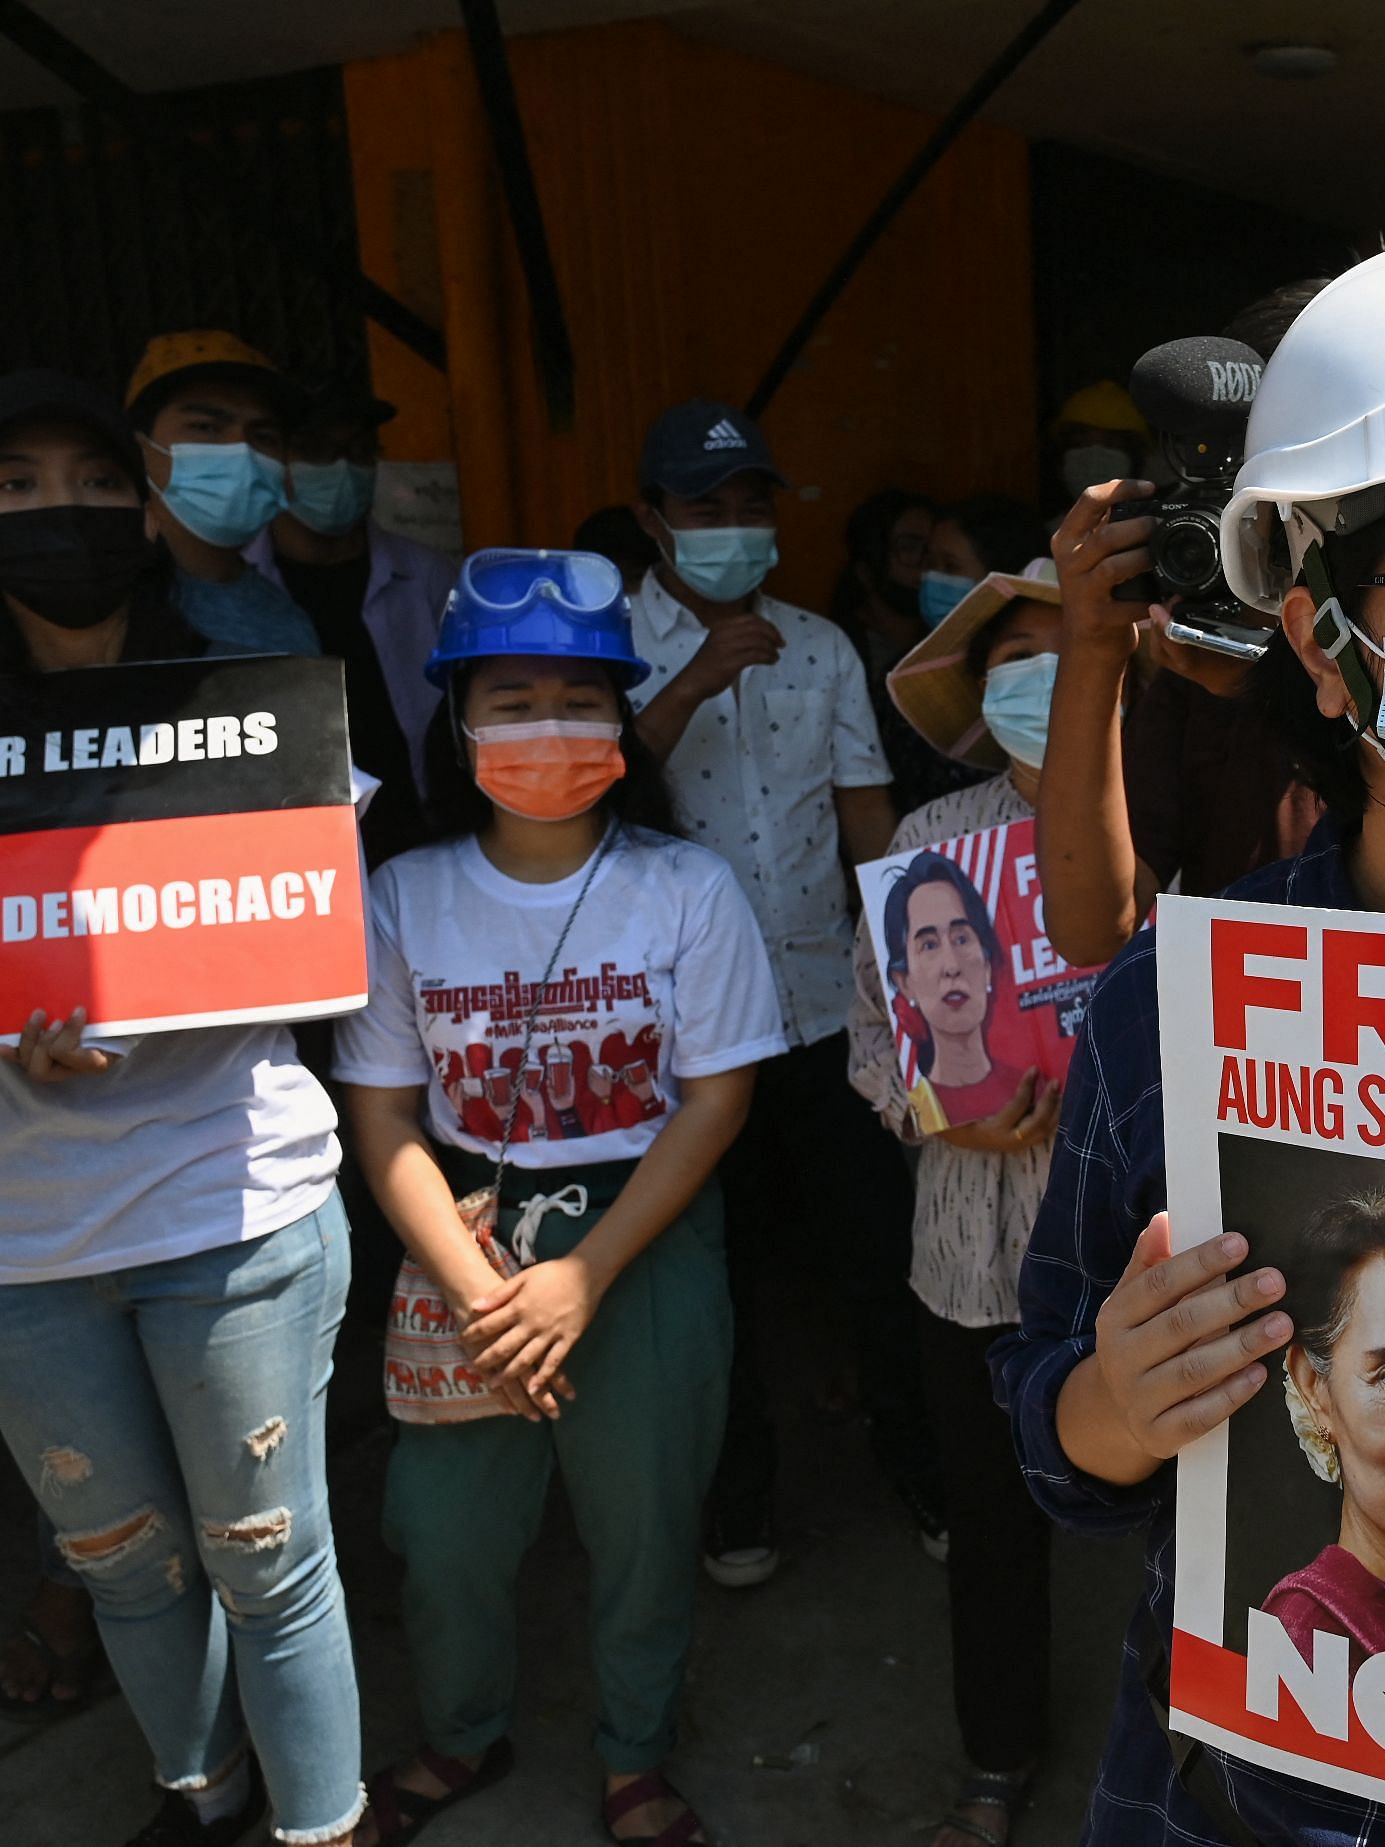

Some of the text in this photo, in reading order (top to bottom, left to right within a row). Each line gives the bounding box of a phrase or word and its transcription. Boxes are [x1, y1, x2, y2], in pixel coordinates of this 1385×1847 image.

[1161, 503, 1189, 511] SONY
[43, 711, 278, 773] LEADERS
[3, 868, 337, 942] DEMOCRACY
[1217, 1055, 1344, 1140] AUNG
